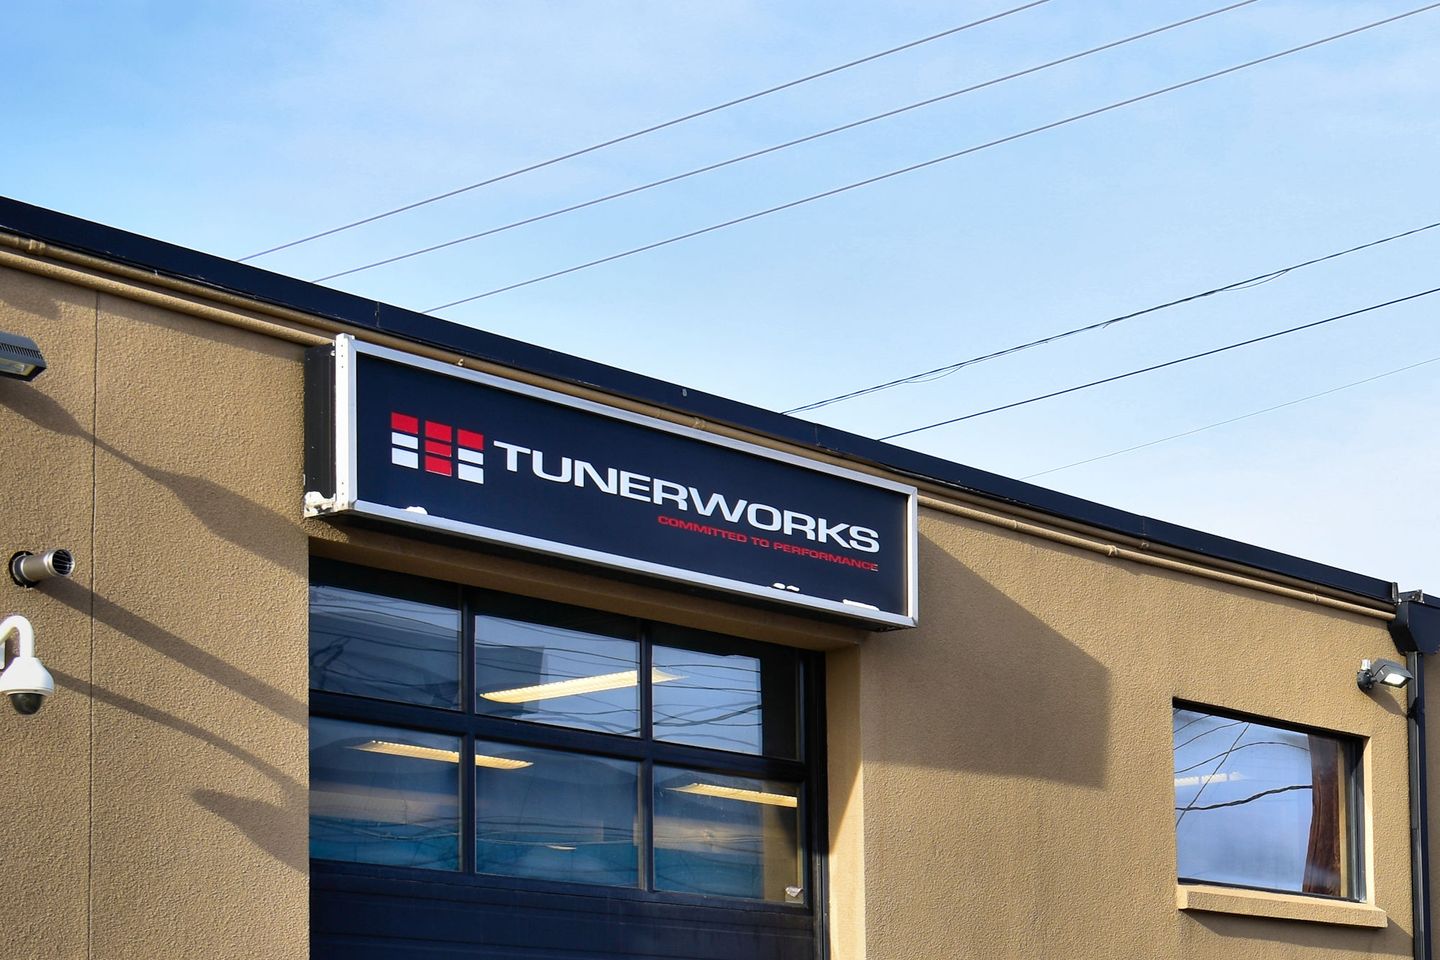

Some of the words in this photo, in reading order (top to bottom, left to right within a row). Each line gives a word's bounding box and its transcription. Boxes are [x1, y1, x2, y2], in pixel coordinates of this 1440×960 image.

[493, 440, 880, 553] TUNERWORKS
[657, 515, 748, 543] COMMITTED
[750, 535, 770, 548] TO
[773, 541, 879, 572] PERFORMANCE
